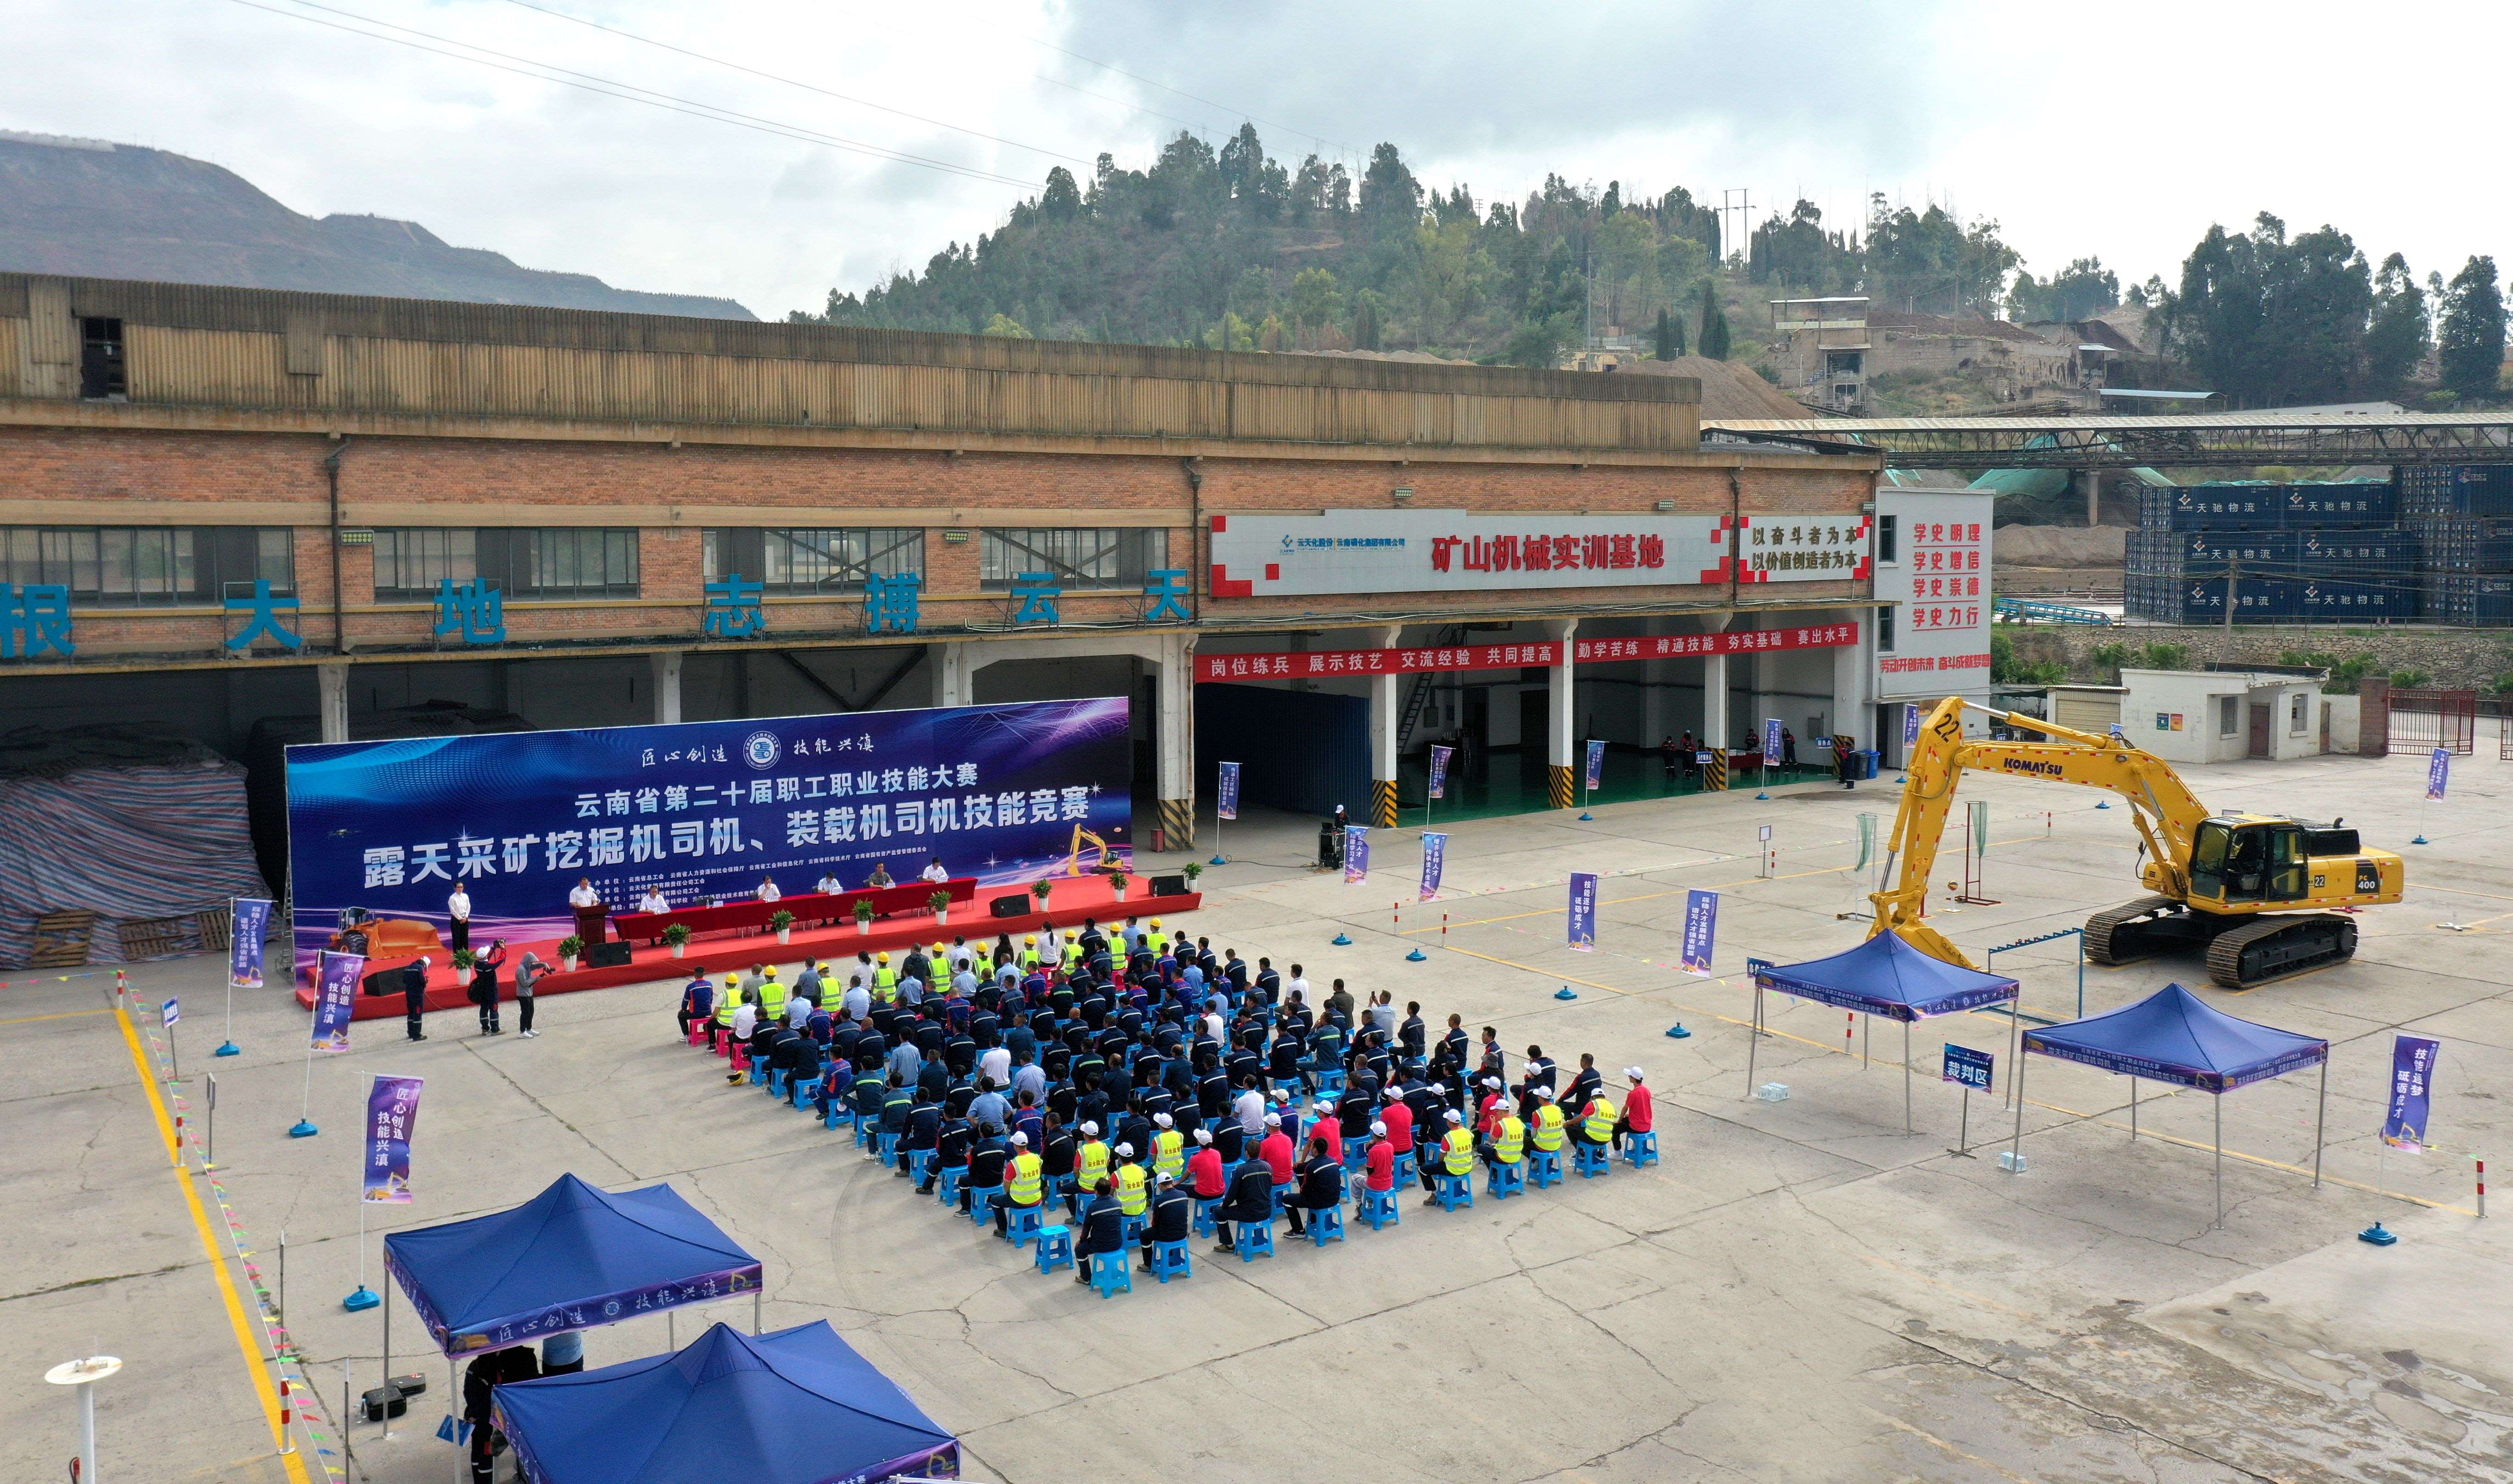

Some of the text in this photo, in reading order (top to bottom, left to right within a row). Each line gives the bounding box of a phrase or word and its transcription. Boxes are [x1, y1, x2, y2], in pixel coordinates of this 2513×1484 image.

[2197, 502, 2256, 513] 天驰物流
[2308, 500, 2367, 511] 天驰物流
[1752, 526, 1857, 545] 以奋斗者为本
[1913, 523, 1980, 543] 学史明理
[1432, 534, 1665, 572] 矿山机械实训基地
[1752, 551, 1857, 570] 以价值创造者为本
[1913, 551, 1979, 571] 学史增信
[2326, 548, 2386, 557] 天驰物流
[1913, 577, 1978, 597] 学史崇德
[2210, 596, 2269, 606] 天物流
[2324, 595, 2384, 605] 天驰物流
[1912, 606, 1978, 628] 学史力行
[1578, 627, 1848, 658] 勤学苦练 精通技能 夯实基础 赛出水平
[1211, 645, 1552, 677] 岗位练兵 展示技艺 交流经验 共同提高
[1881, 657, 1934, 673] 劳动开创未来
[1933, 713, 1960, 742] 22
[642, 744, 727, 768] 匠心创造
[794, 733, 874, 756] 技能兴滇
[2004, 758, 2063, 776] KOMATSU
[574, 762, 978, 819] 云南省第二十届职工职业技能大赛
[363, 786, 1089, 889] 露天采矿挖掘机司机、装载机司机技能竞赛
[628, 874, 664, 883] 云南省总工会
[2315, 876, 2324, 886] 22
[340, 963, 354, 1006] 匠心创造
[323, 982, 339, 1024] 技能兴滇
[1948, 1061, 1988, 1085] 裁判区
[2410, 1048, 2428, 1096] 技能逐梦
[391, 1088, 410, 1140] 匠心创造
[375, 1111, 391, 1166] 技能兴滇
[499, 1279, 720, 1343] 匠心创造 技能兴滇
